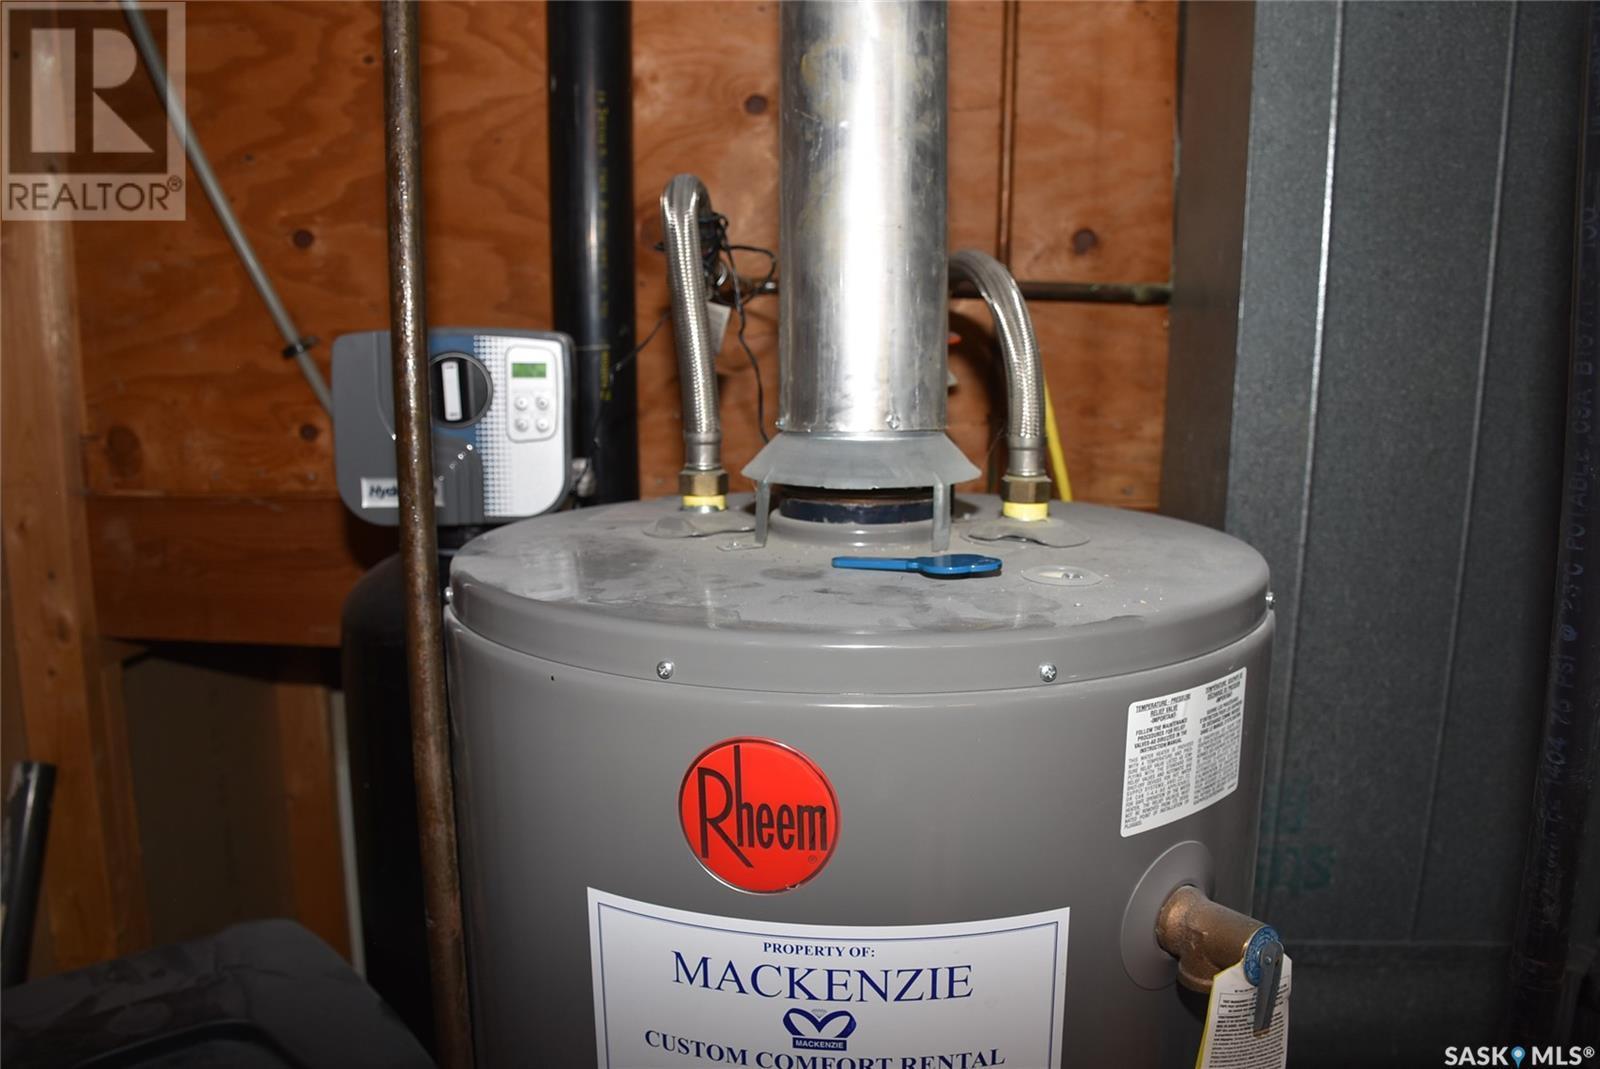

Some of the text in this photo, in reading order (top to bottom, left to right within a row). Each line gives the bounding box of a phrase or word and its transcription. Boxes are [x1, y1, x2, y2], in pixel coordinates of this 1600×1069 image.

[697, 744, 828, 868] Rheem
[763, 941, 876, 959] PROPERTY OF:
[671, 951, 974, 1003] MACKENZIE
[645, 1029, 1006, 1069] CUSTOM COMFORT RENTAL
[795, 1039, 845, 1049] MACKENZIE
